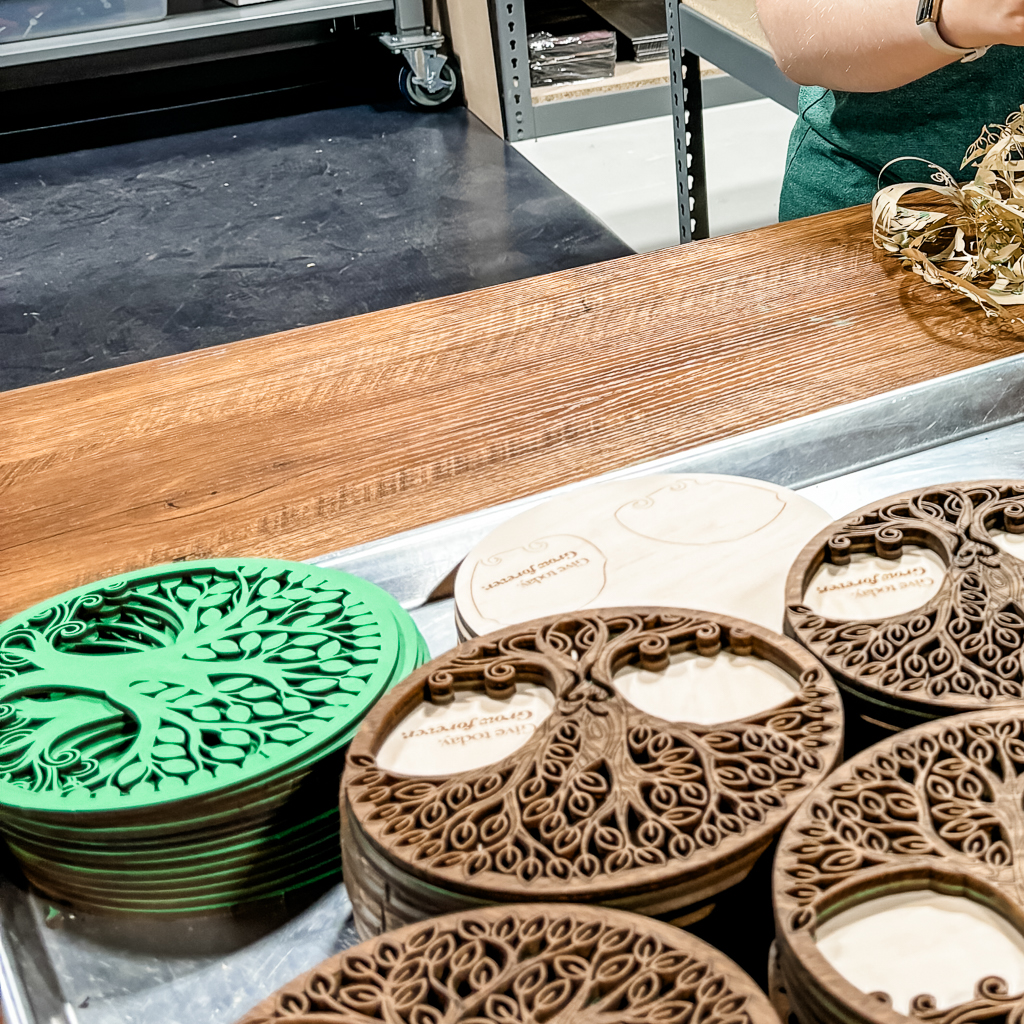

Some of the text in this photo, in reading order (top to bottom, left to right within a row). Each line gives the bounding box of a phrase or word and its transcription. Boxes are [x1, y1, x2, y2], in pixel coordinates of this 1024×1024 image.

[481, 550, 578, 591] Grow forever.
[516, 558, 590, 588] Give today.
[817, 566, 926, 594] Grow forever.
[851, 577, 934, 598] Give today.
[401, 709, 533, 739] Grow forever.
[438, 723, 537, 747] Give today.
